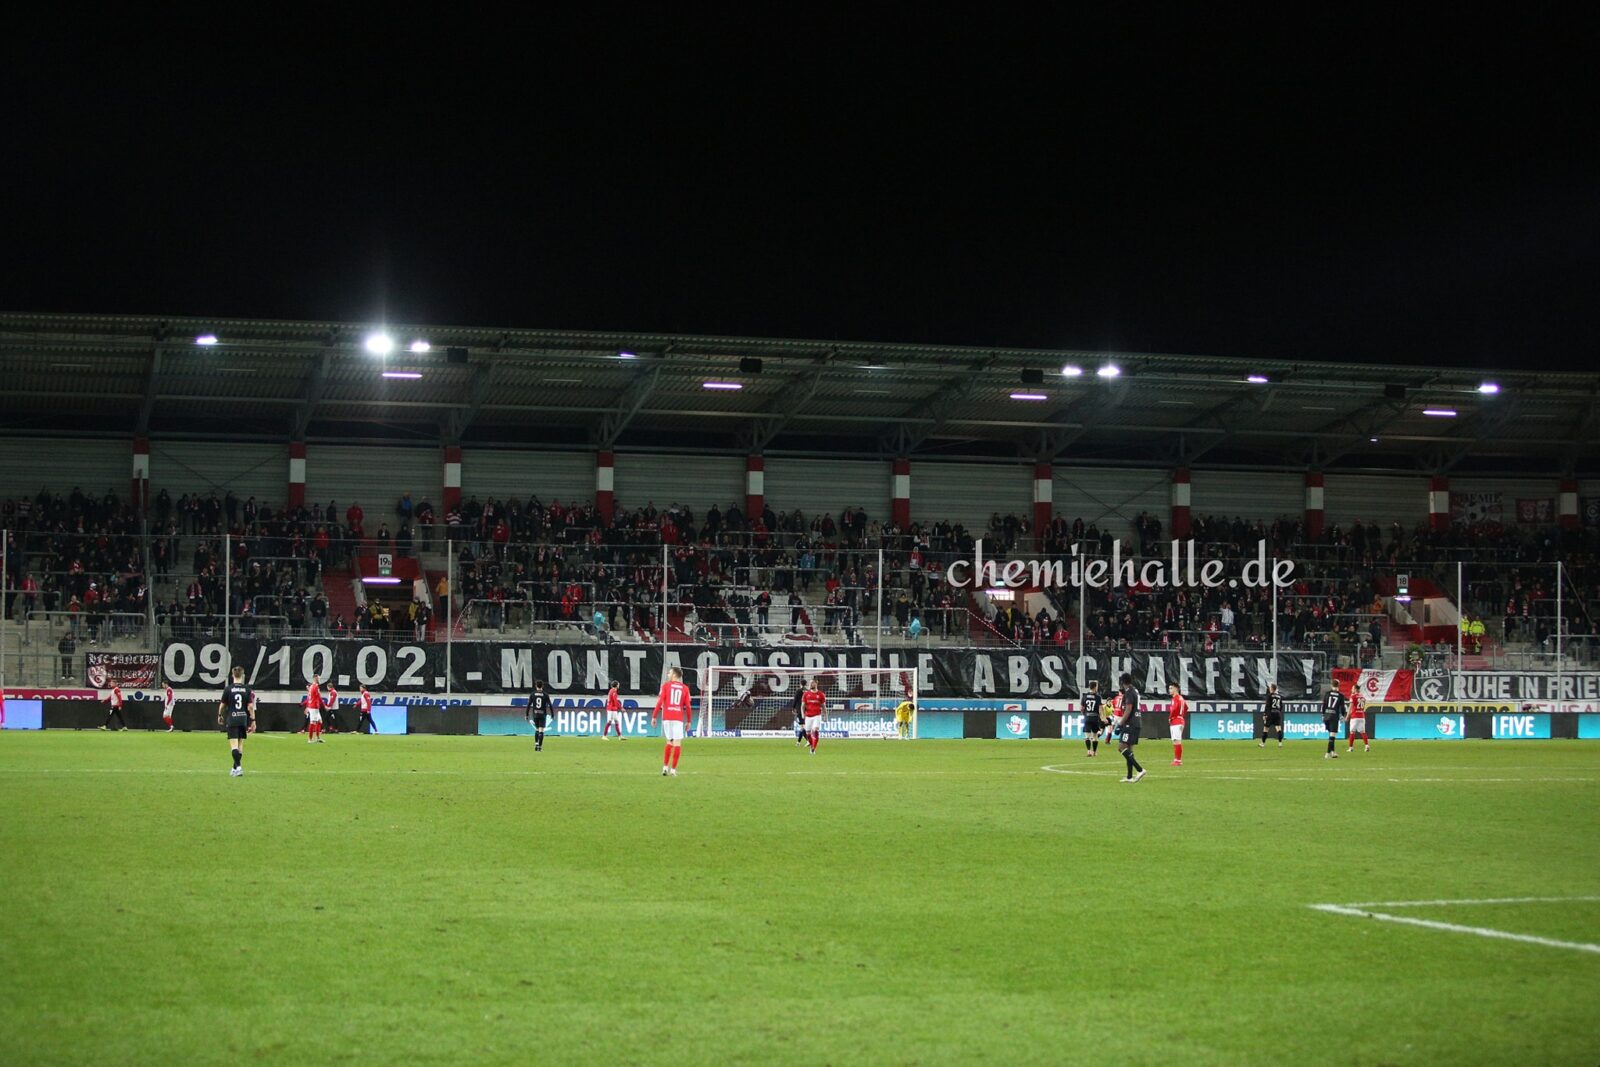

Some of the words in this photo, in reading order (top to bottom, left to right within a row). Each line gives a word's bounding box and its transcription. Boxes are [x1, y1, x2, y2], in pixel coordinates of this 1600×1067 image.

[1421, 668, 1443, 677] HFC
[1453, 676, 1511, 699] RUHE
[1518, 676, 1539, 699] IN
[1547, 676, 1600, 699] FRIE
[234, 693, 243, 710] 3
[535, 697, 542, 709] 9
[670, 688, 682, 705] 10
[1271, 698, 1281, 709] 24
[1327, 696, 1339, 708] 17
[1085, 699, 1096, 711] 37
[557, 711, 601, 733] HIGH
[606, 711, 648, 733] IVE
[1217, 719, 1224, 733] 5
[1500, 716, 1535, 736] FIVE
